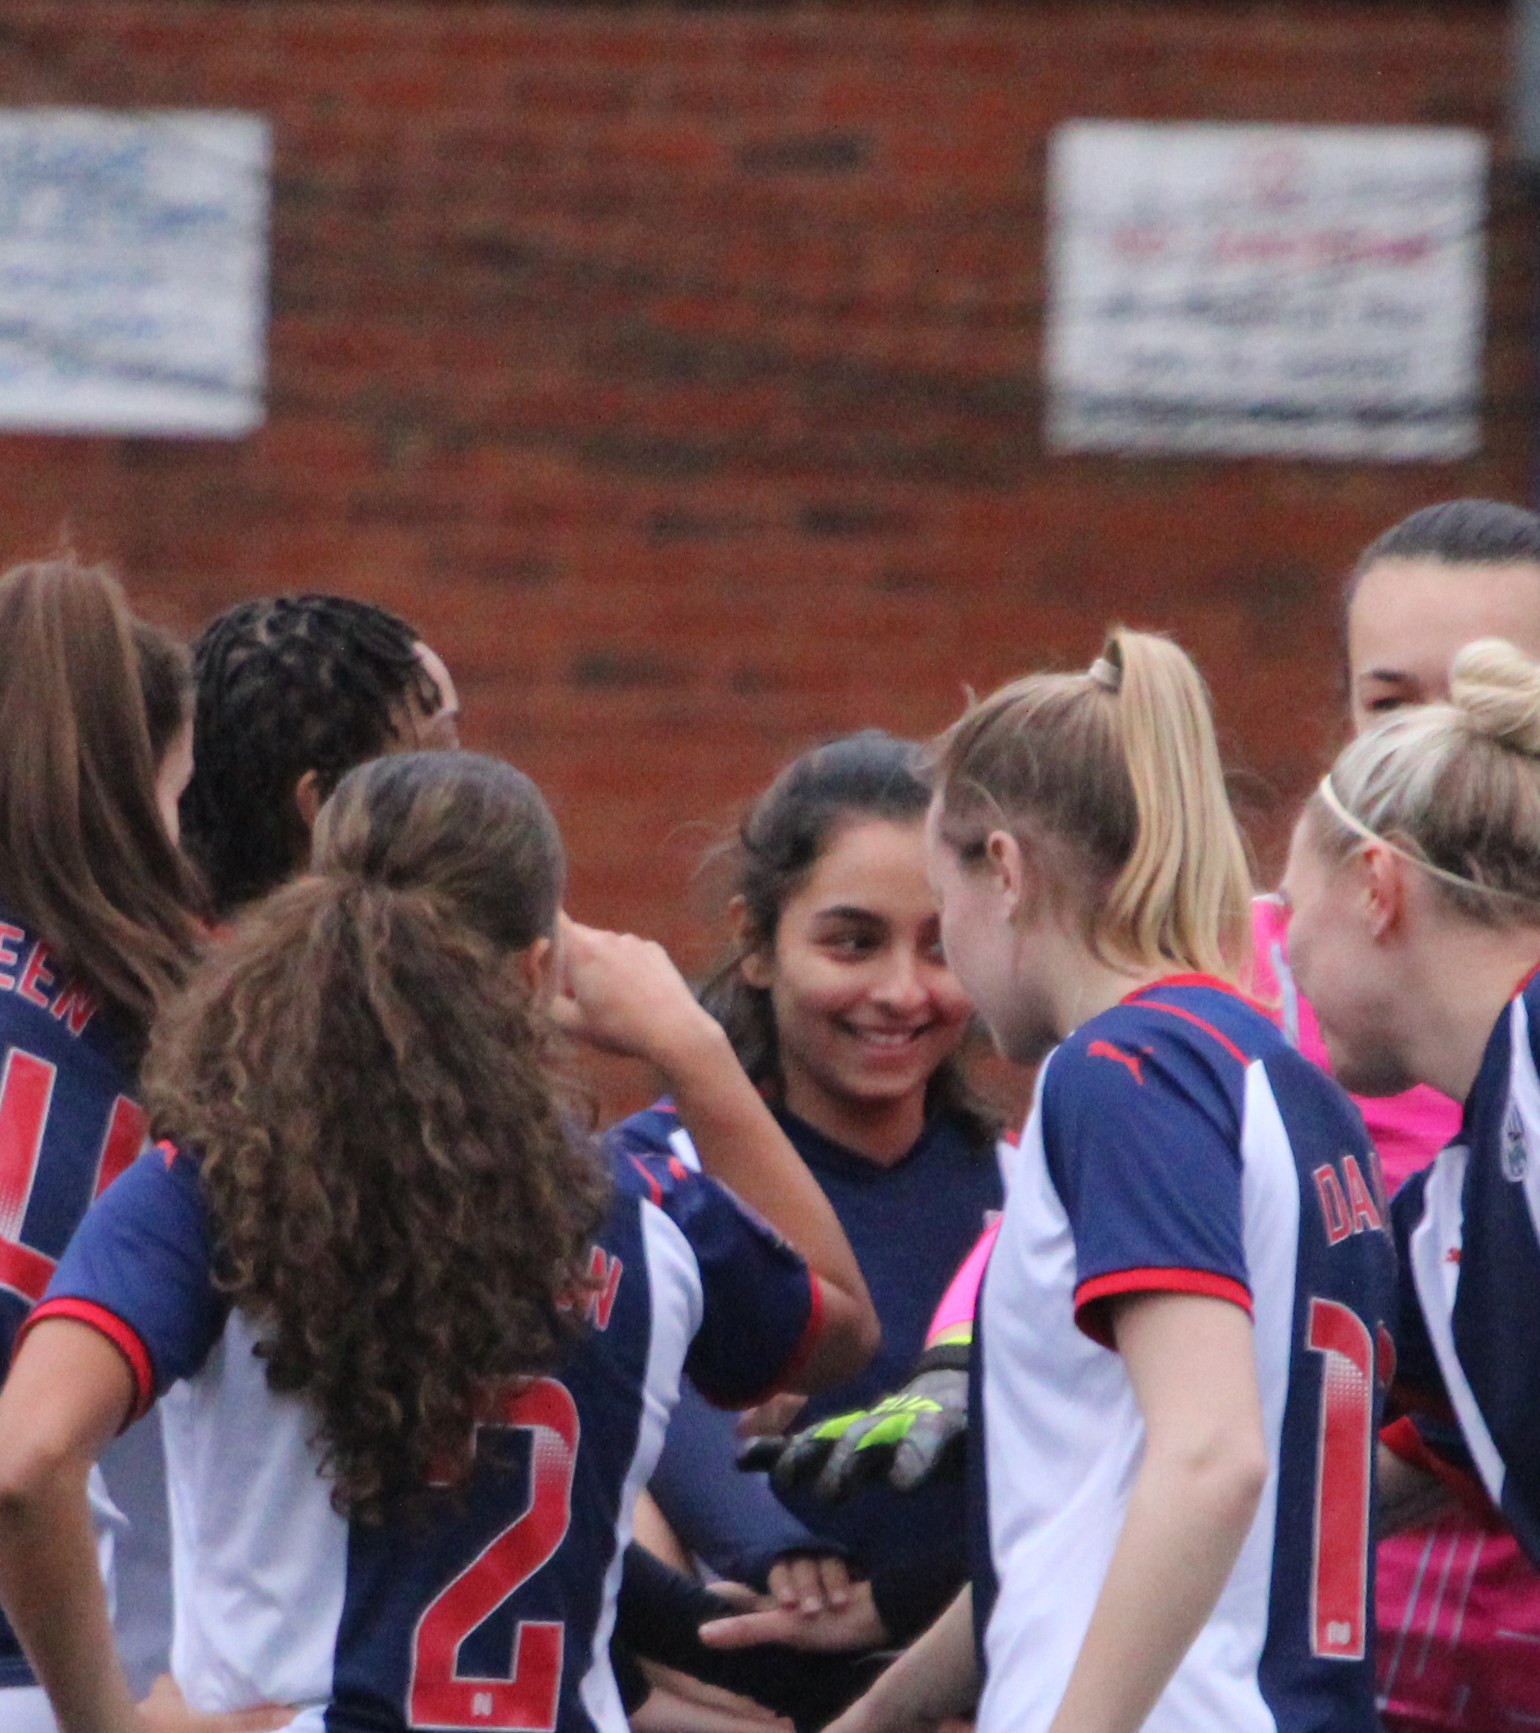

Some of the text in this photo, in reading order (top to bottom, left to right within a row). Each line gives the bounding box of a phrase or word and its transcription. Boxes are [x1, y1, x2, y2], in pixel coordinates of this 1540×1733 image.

[1313, 1152, 1395, 1246] DA
[407, 1376, 581, 1733] 2
[1305, 1297, 1397, 1661] 1
